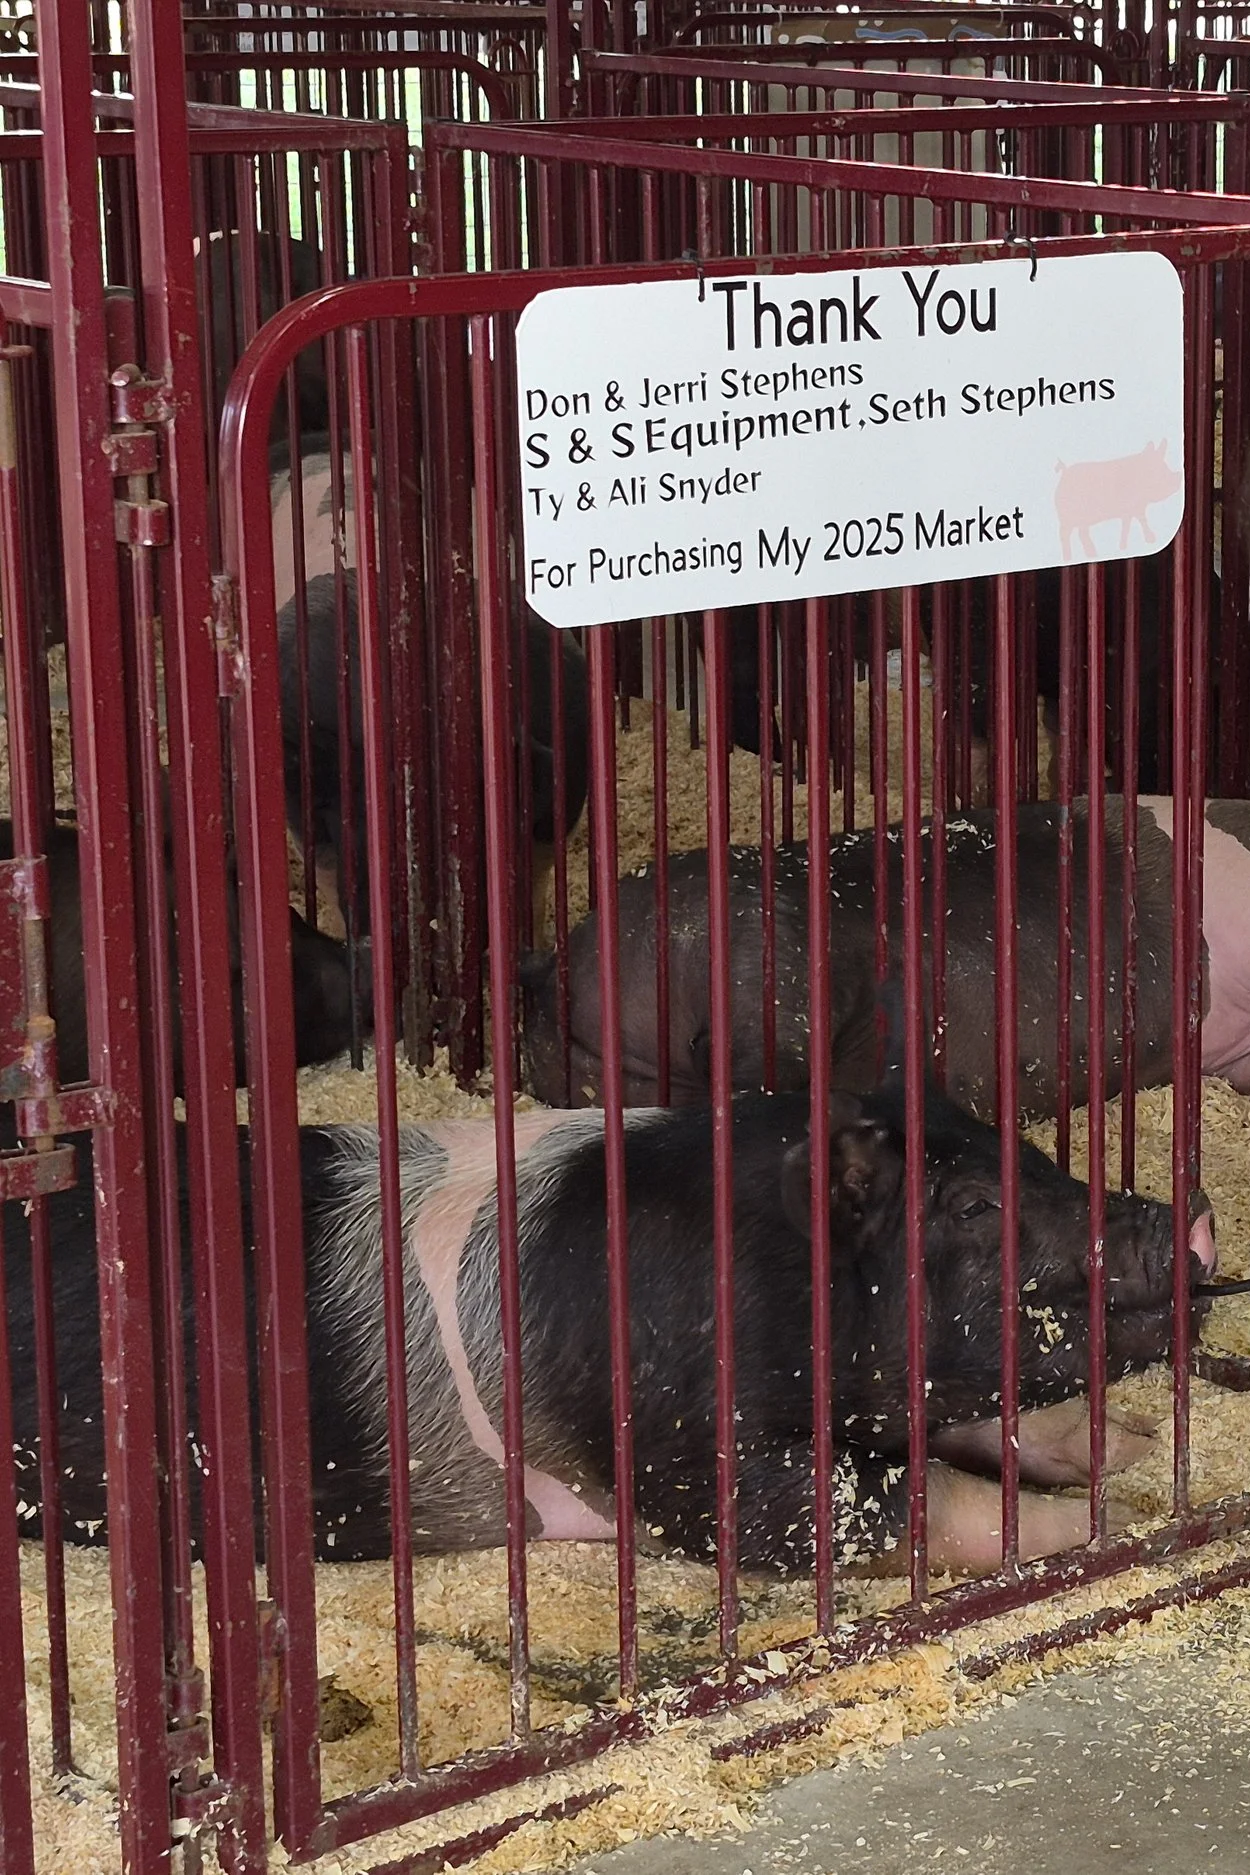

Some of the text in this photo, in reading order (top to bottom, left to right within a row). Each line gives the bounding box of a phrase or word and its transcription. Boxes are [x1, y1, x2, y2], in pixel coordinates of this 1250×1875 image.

[712, 269, 998, 351] Thank You
[526, 362, 865, 421] Don & Jerri Stephens
[526, 432, 551, 469] S
[568, 427, 597, 465] &
[611, 422, 636, 459] S
[960, 377, 1117, 417] Stephens
[527, 467, 763, 522] Ty & Ali Snyder
[530, 505, 1025, 595] For Purchasing My 2025 Market
